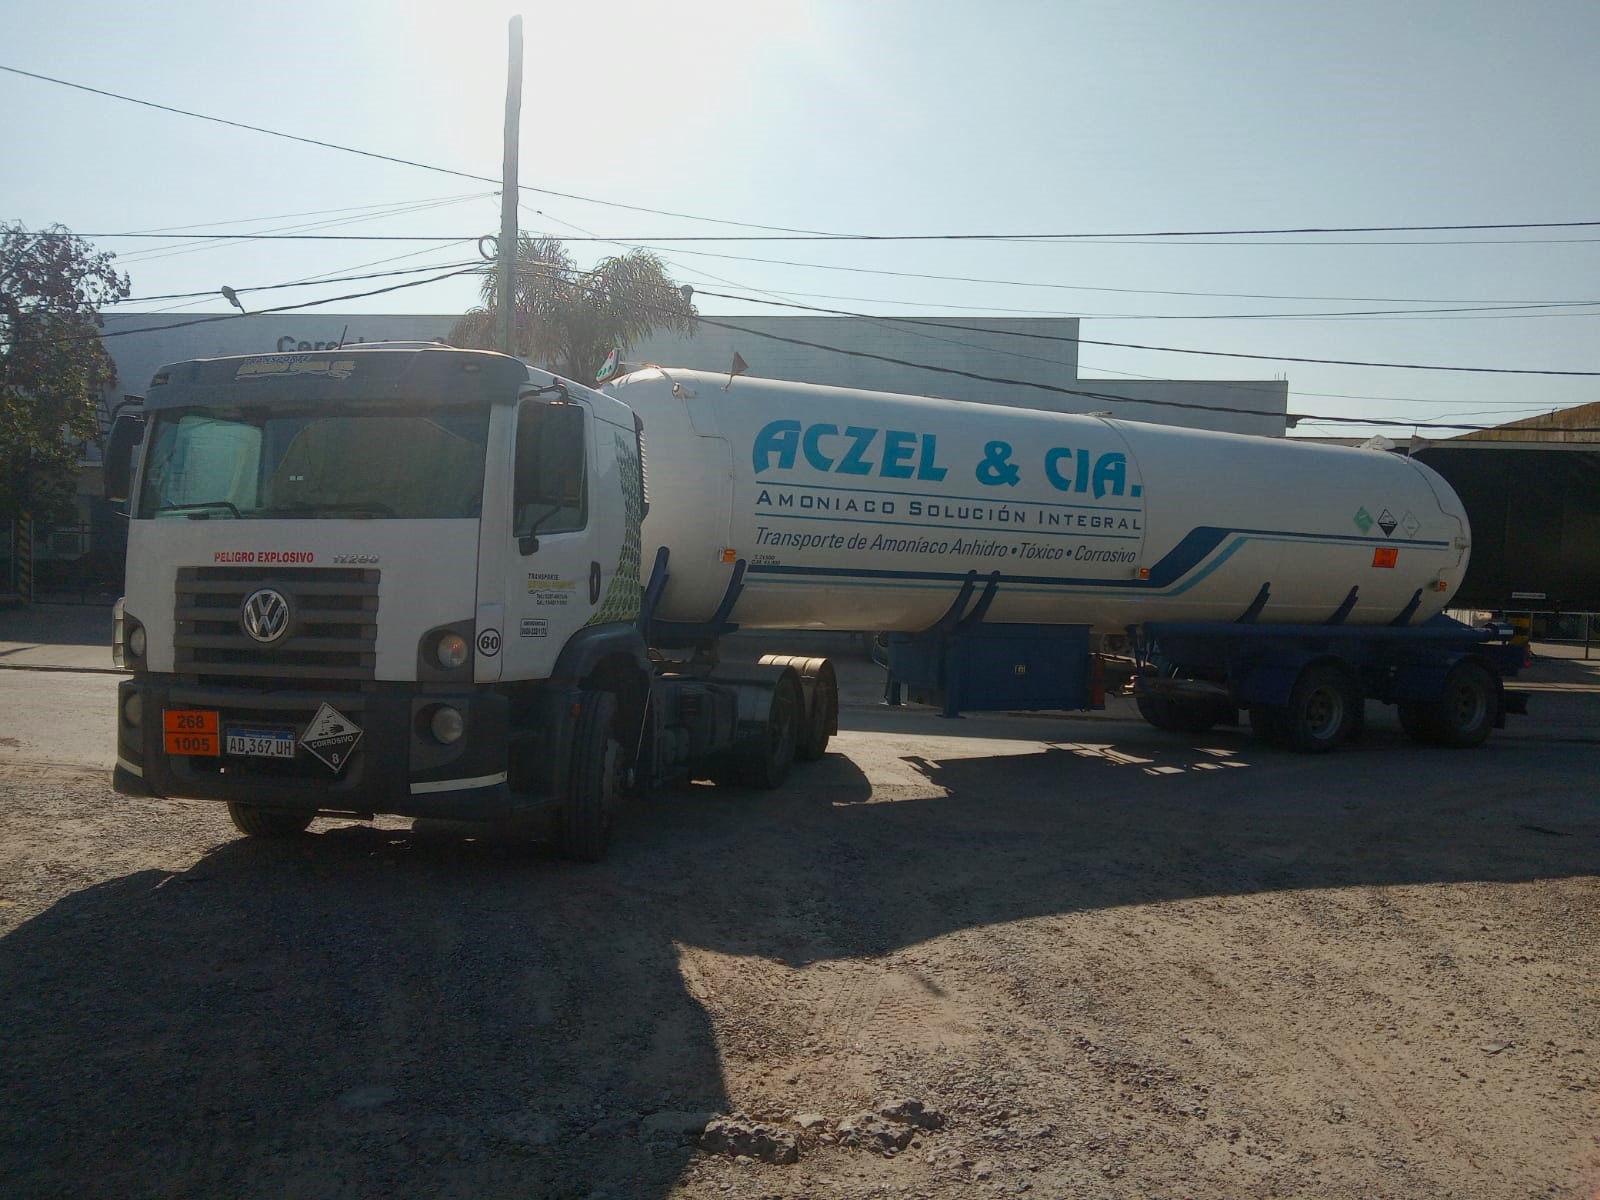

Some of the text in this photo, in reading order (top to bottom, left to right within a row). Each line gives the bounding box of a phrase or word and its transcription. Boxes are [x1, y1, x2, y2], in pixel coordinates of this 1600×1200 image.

[753, 419, 1143, 500] ACZEL & CIA.
[756, 490, 1141, 530] AMONIACO SOLUCIÓN INTEGRAL
[755, 526, 1137, 563] Transporte de Amoníaco Anhidro Tóxico Corrosivo
[214, 552, 314, 563] PELIGRO EXPLOSIVO
[480, 635, 499, 650] 60
[177, 714, 205, 729] 268
[173, 737, 210, 752] 1005
[311, 735, 354, 749] CORROSIVO
[331, 753, 340, 764] 8
